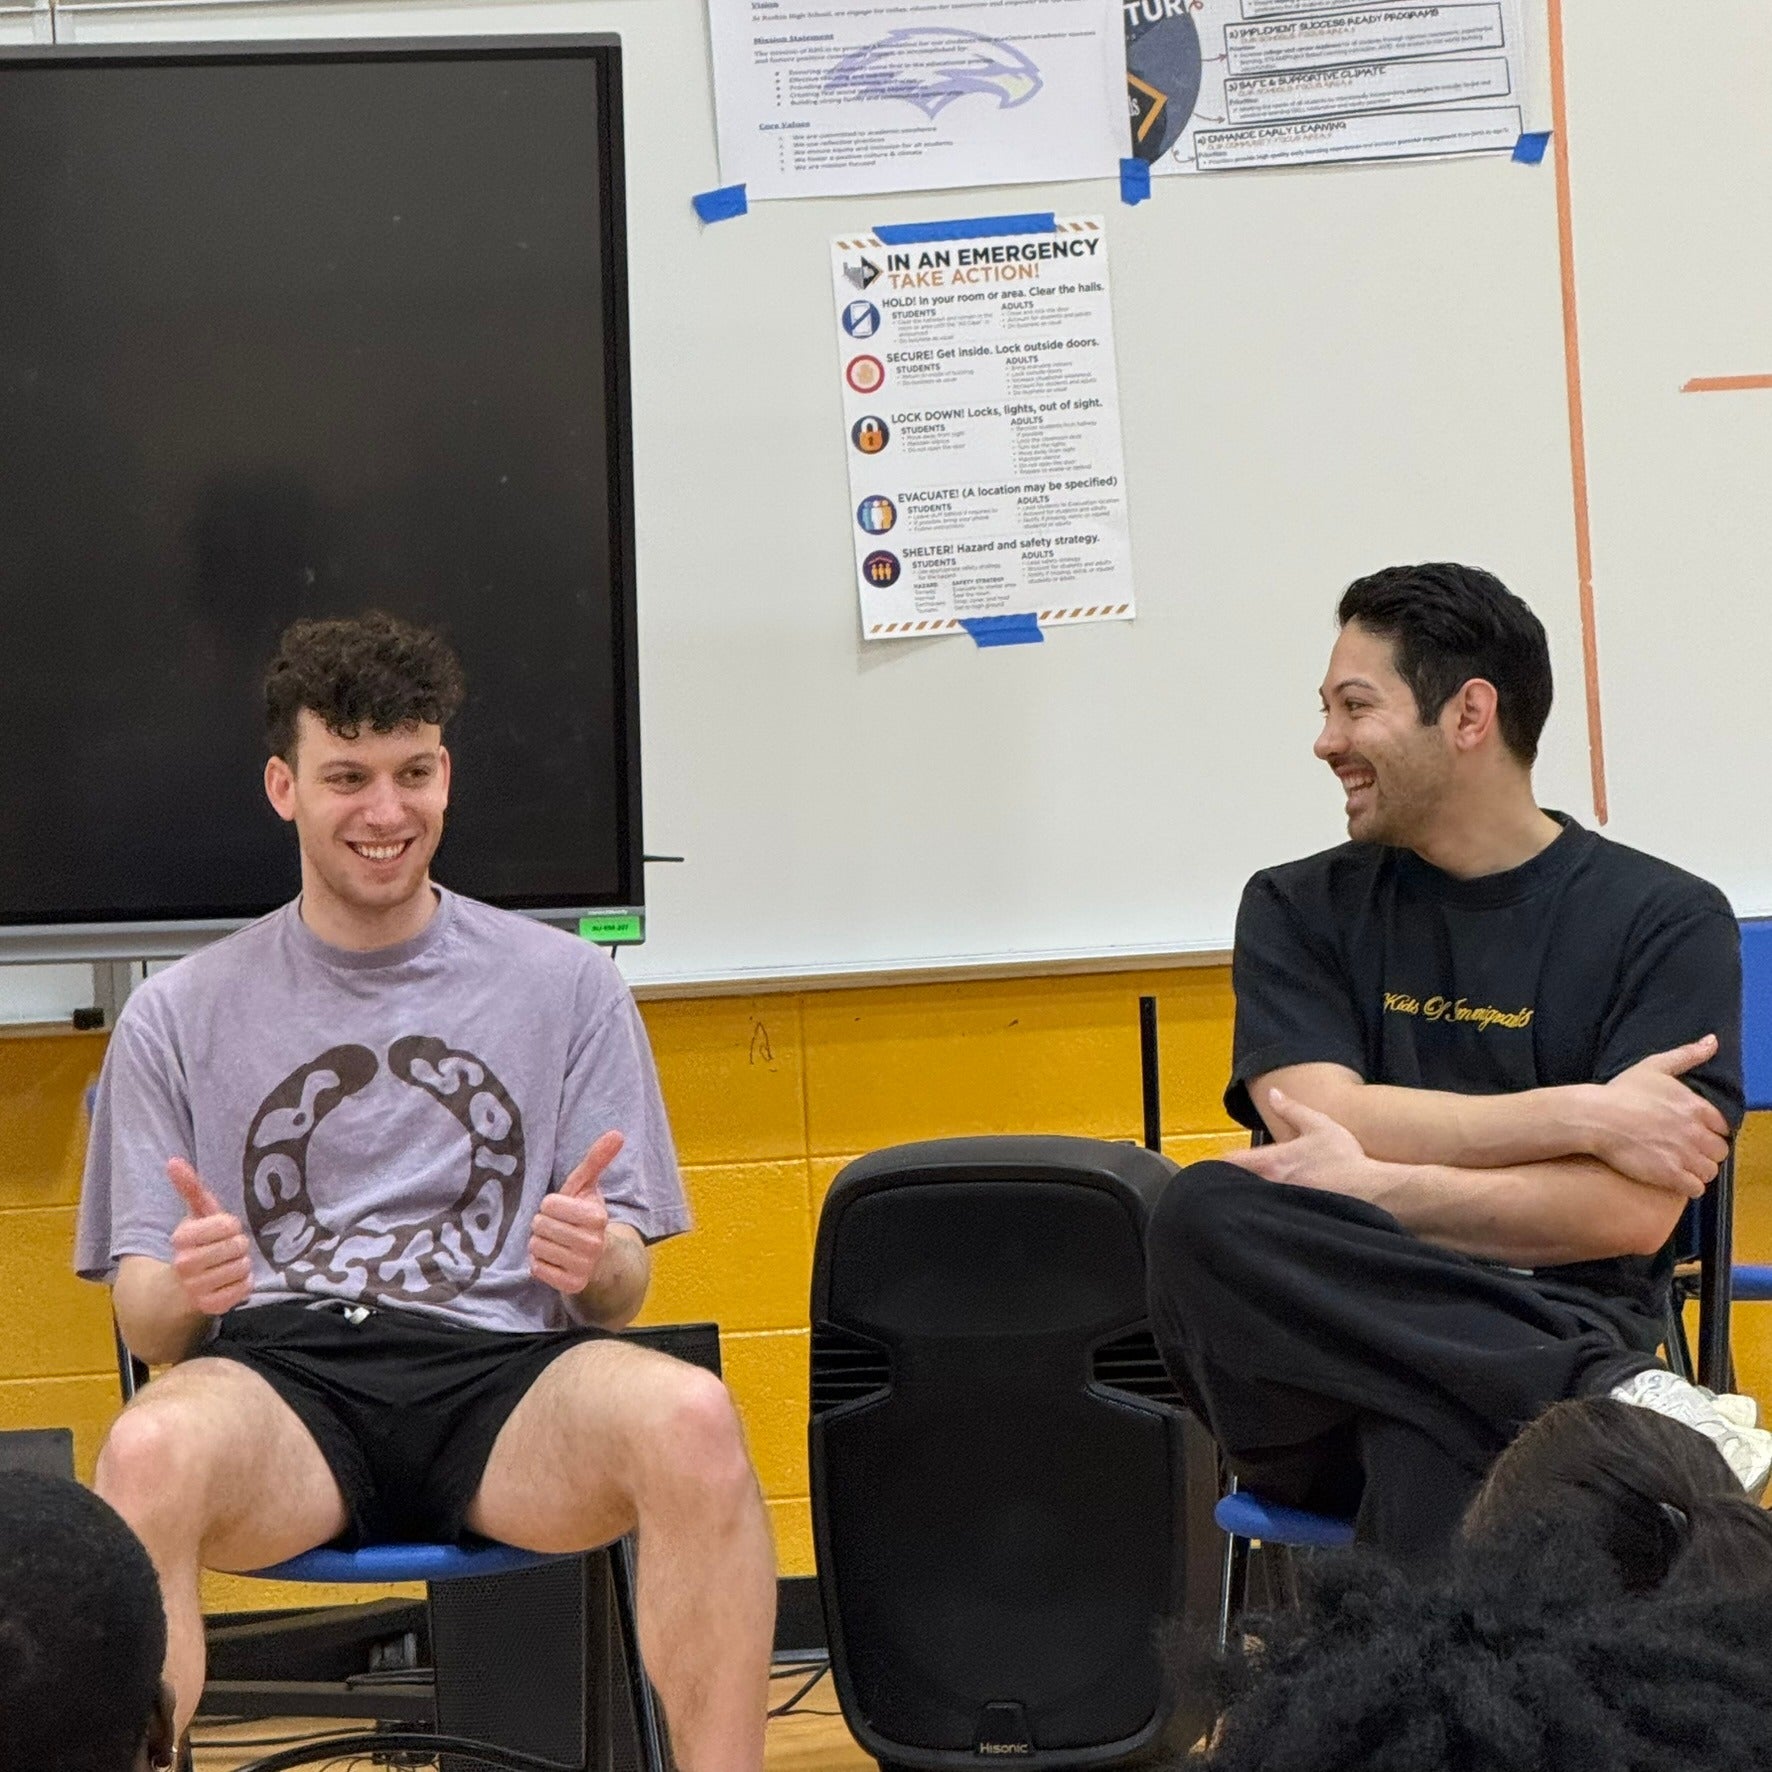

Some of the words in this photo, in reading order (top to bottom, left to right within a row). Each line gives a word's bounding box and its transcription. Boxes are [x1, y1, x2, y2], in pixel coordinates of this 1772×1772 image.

[1122, 0, 1191, 26] TUR
[1240, 23, 1297, 37] IMPLEMENT
[1299, 18, 1346, 31] SUCCESS
[1347, 14, 1381, 28] READY
[1384, 8, 1439, 21] PROGRAMS
[754, 36, 787, 44] Mission
[789, 33, 833, 42] Statement
[1240, 79, 1267, 91] SAFE
[1278, 71, 1340, 86] SUPPORTIVE
[1340, 66, 1387, 80] CLIMATE
[759, 122, 778, 130] Core
[781, 120, 809, 128] Values
[1207, 131, 1256, 144] ENHANCE
[1258, 126, 1292, 138] EARLY
[1294, 121, 1346, 134] LEARNING
[887, 253, 909, 271] IN
[917, 250, 950, 269] AN
[958, 238, 1100, 266] EMERGENCY
[888, 270, 943, 290] TAKE
[951, 262, 1039, 284] ACTION!
[881, 297, 916, 308] HOLD!
[932, 295, 953, 305] your
[958, 293, 983, 302] room
[1001, 290, 1025, 298] area.
[1029, 285, 1055, 296] Clear
[1059, 283, 1075, 293] the
[1078, 281, 1104, 291] halls.
[1001, 301, 1033, 310] ADULTS
[892, 309, 936, 319] STUDENTS
[886, 350, 933, 362] SECURE!
[936, 348, 955, 358] Get
[995, 343, 1020, 353] Lock
[1024, 339, 1063, 351] outside
[1065, 336, 1099, 347] doors.
[1005, 355, 1038, 364] ADULTS
[896, 363, 940, 373] STUDENTS
[891, 412, 921, 423] LOCK
[924, 408, 964, 420] DOWN!
[968, 405, 1001, 418] Locks,
[1003, 402, 1036, 416] lights,
[1039, 401, 1056, 411] out
[1059, 400, 1070, 409] of
[1073, 397, 1102, 410] sight.
[1010, 416, 1043, 425] ADULTS
[901, 424, 945, 434] STUDENTS
[898, 489, 958, 502] EVACUATE!
[962, 488, 975, 498] (A
[978, 484, 1020, 496] location
[1024, 484, 1045, 493] may
[1048, 480, 1061, 490] be
[1064, 476, 1117, 490] specified)
[1017, 495, 1049, 504] ADULTS
[907, 503, 951, 513] STUDENTS
[902, 544, 953, 557] SHELTER!
[956, 541, 993, 553] Hazard
[997, 539, 1016, 549] and
[1019, 536, 1051, 549] safety
[1054, 533, 1099, 546] strategy.
[1021, 549, 1054, 559] ADULTS
[912, 558, 956, 568] STUDENTS
[1384, 992, 1420, 1014] Kids
[980, 1742, 1029, 1754] Hisonic
